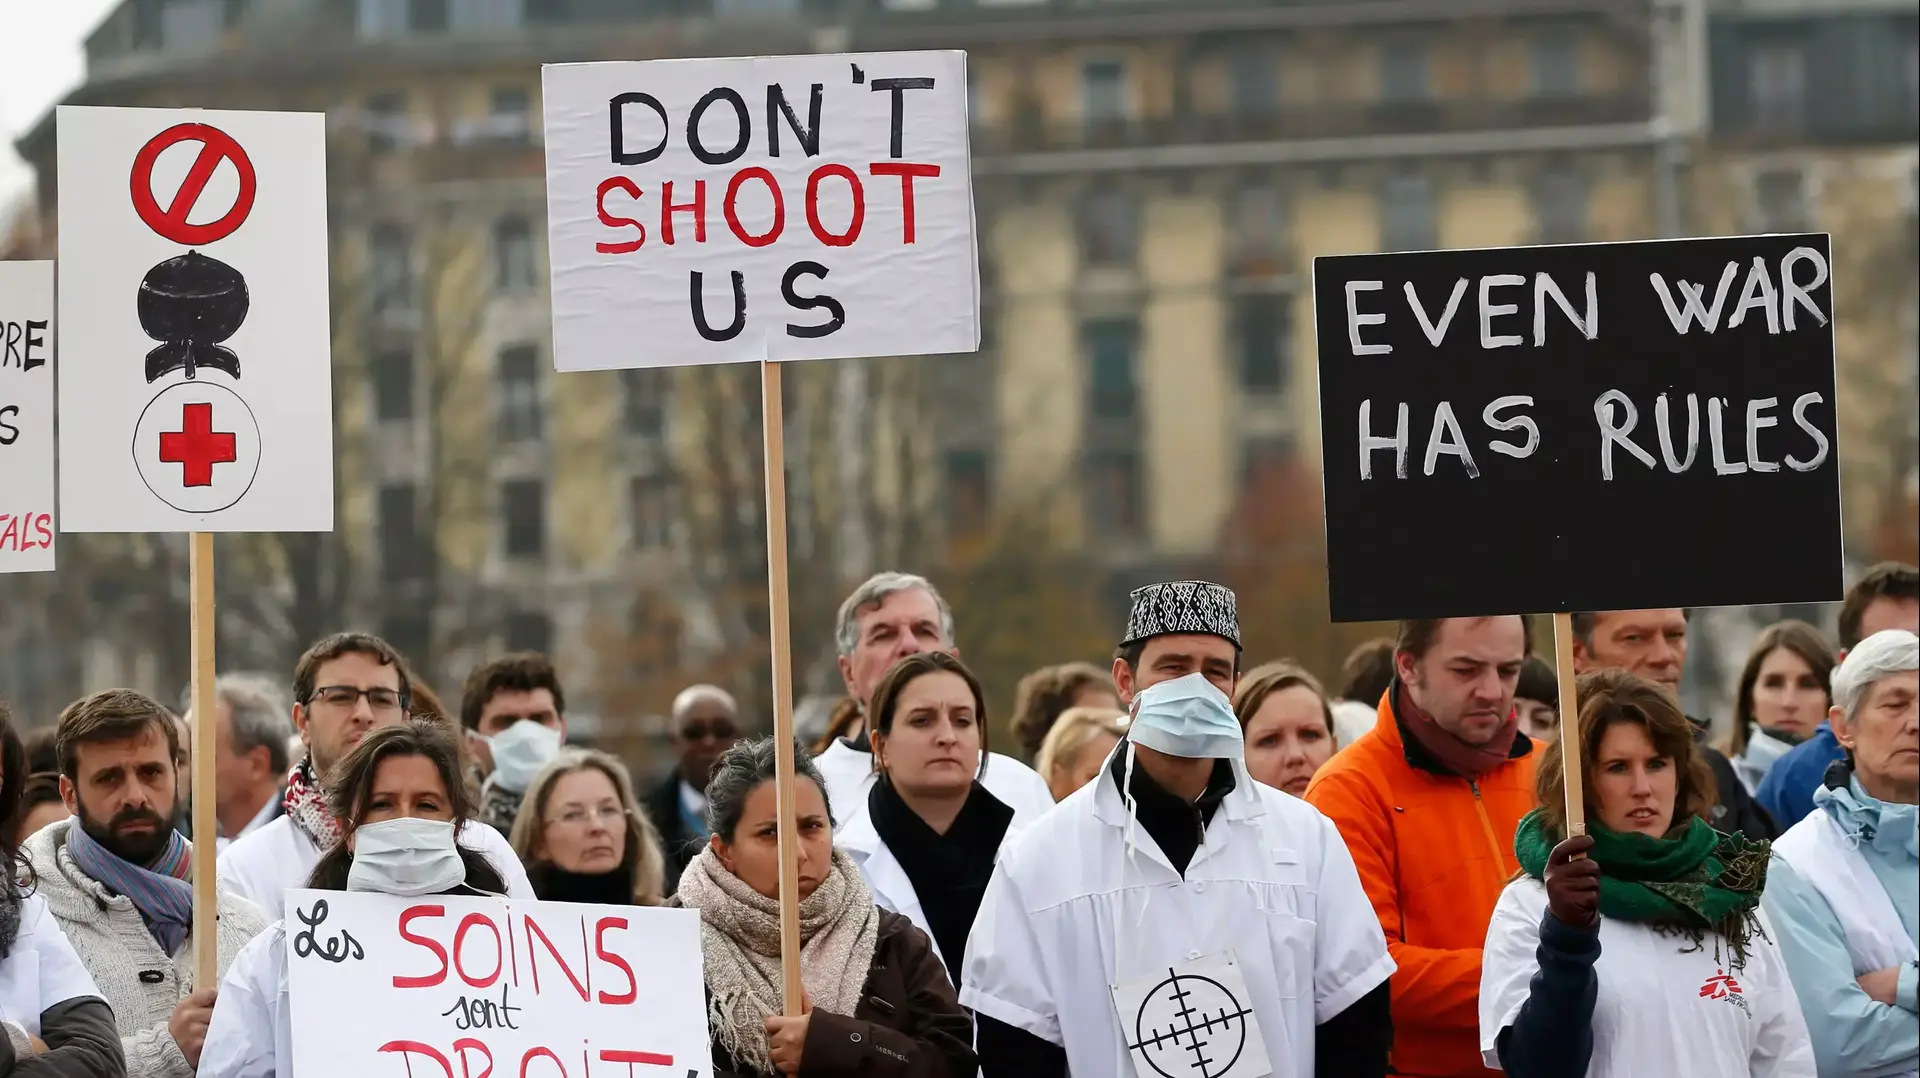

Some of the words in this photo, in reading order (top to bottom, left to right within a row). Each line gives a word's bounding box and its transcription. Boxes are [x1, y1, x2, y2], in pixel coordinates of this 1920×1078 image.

[609, 63, 935, 165] DON'T
[596, 163, 940, 254] SHOOT
[691, 261, 845, 341] US
[1345, 272, 1598, 355] EVEN
[1650, 247, 1828, 334] WAR
[0, 320, 47, 372] RE
[1359, 396, 1540, 480] HAS
[1594, 389, 1828, 481] RULES
[294, 900, 364, 962] Les
[442, 983, 521, 1029] sont
